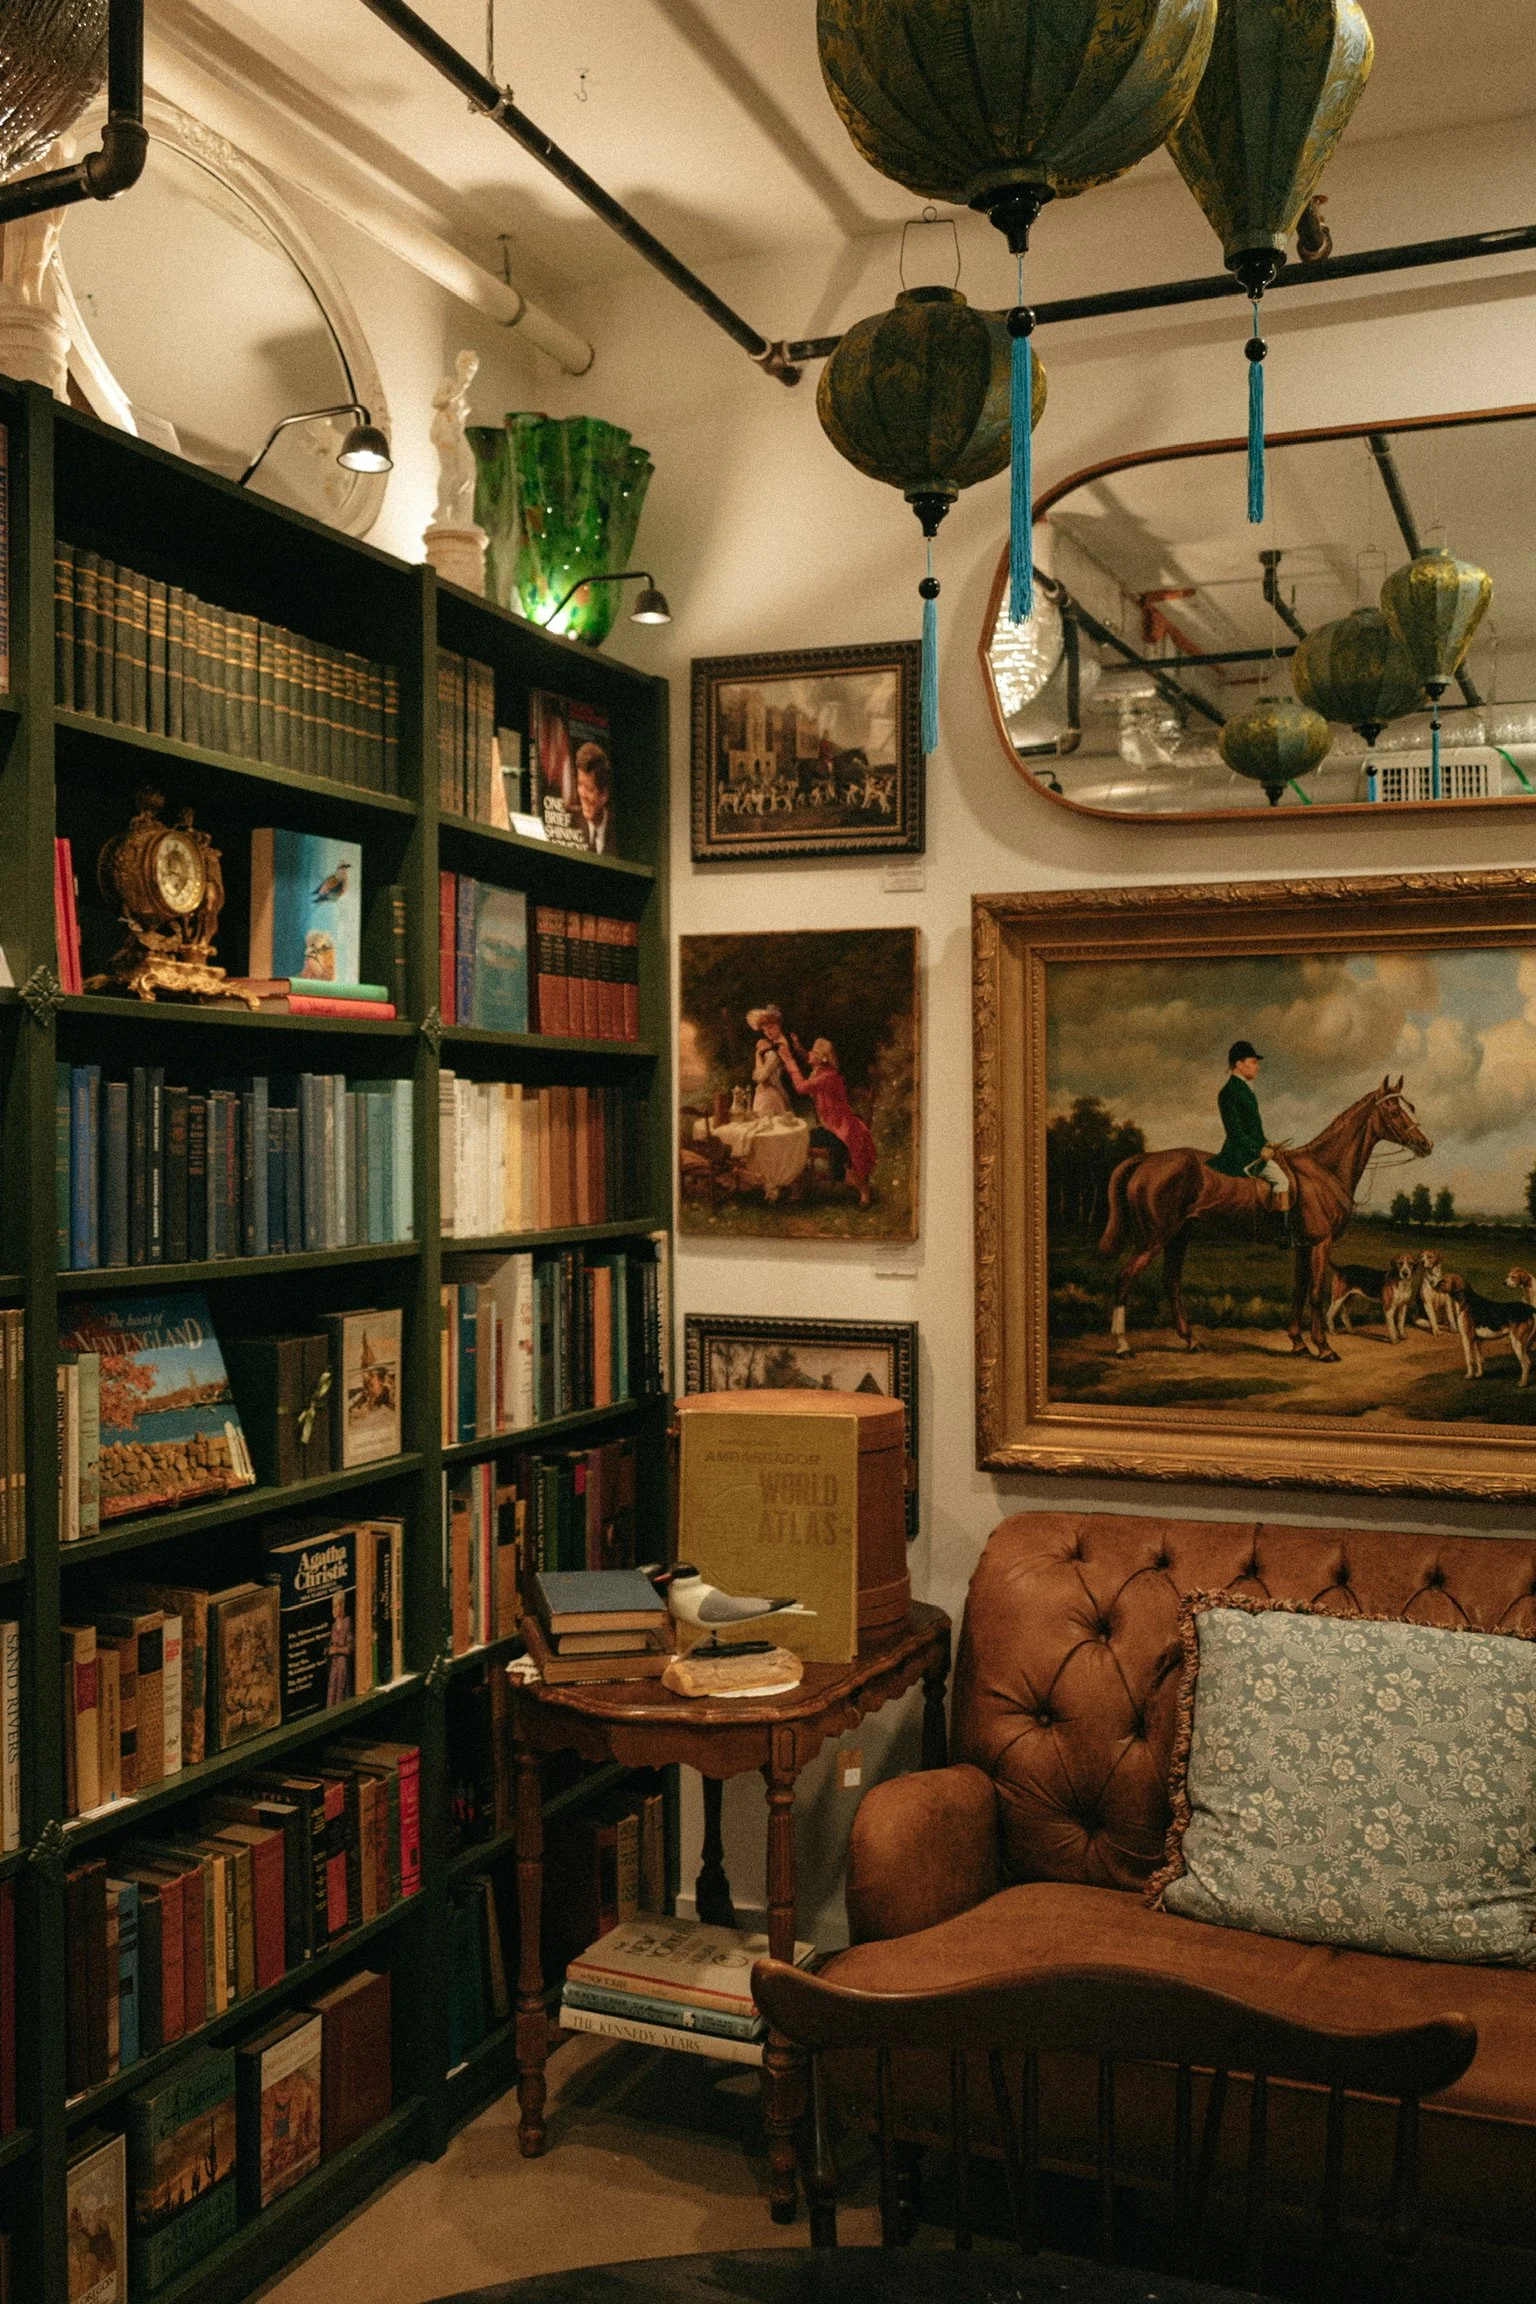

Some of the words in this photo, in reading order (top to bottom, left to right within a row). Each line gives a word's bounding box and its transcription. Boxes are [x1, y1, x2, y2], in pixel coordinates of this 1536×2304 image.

[543, 795, 566, 813] ONE
[544, 810, 572, 827] BRIEF
[545, 825, 585, 843] SHINING
[74, 1329, 121, 1356] NEW
[121, 1317, 204, 1355] ENGLAND
[759, 1472, 838, 1507] WORLD
[758, 1510, 837, 1545] ATLAS
[293, 1560, 349, 1591] Christie
[297, 1545, 347, 1573] Agatha
[7, 1633, 19, 1690] SAND
[7, 1697, 20, 1764] RIVERS
[572, 2015, 595, 2031] THE
[598, 2022, 658, 2043] KENNEDY
[661, 2033, 702, 2052] YEARS
